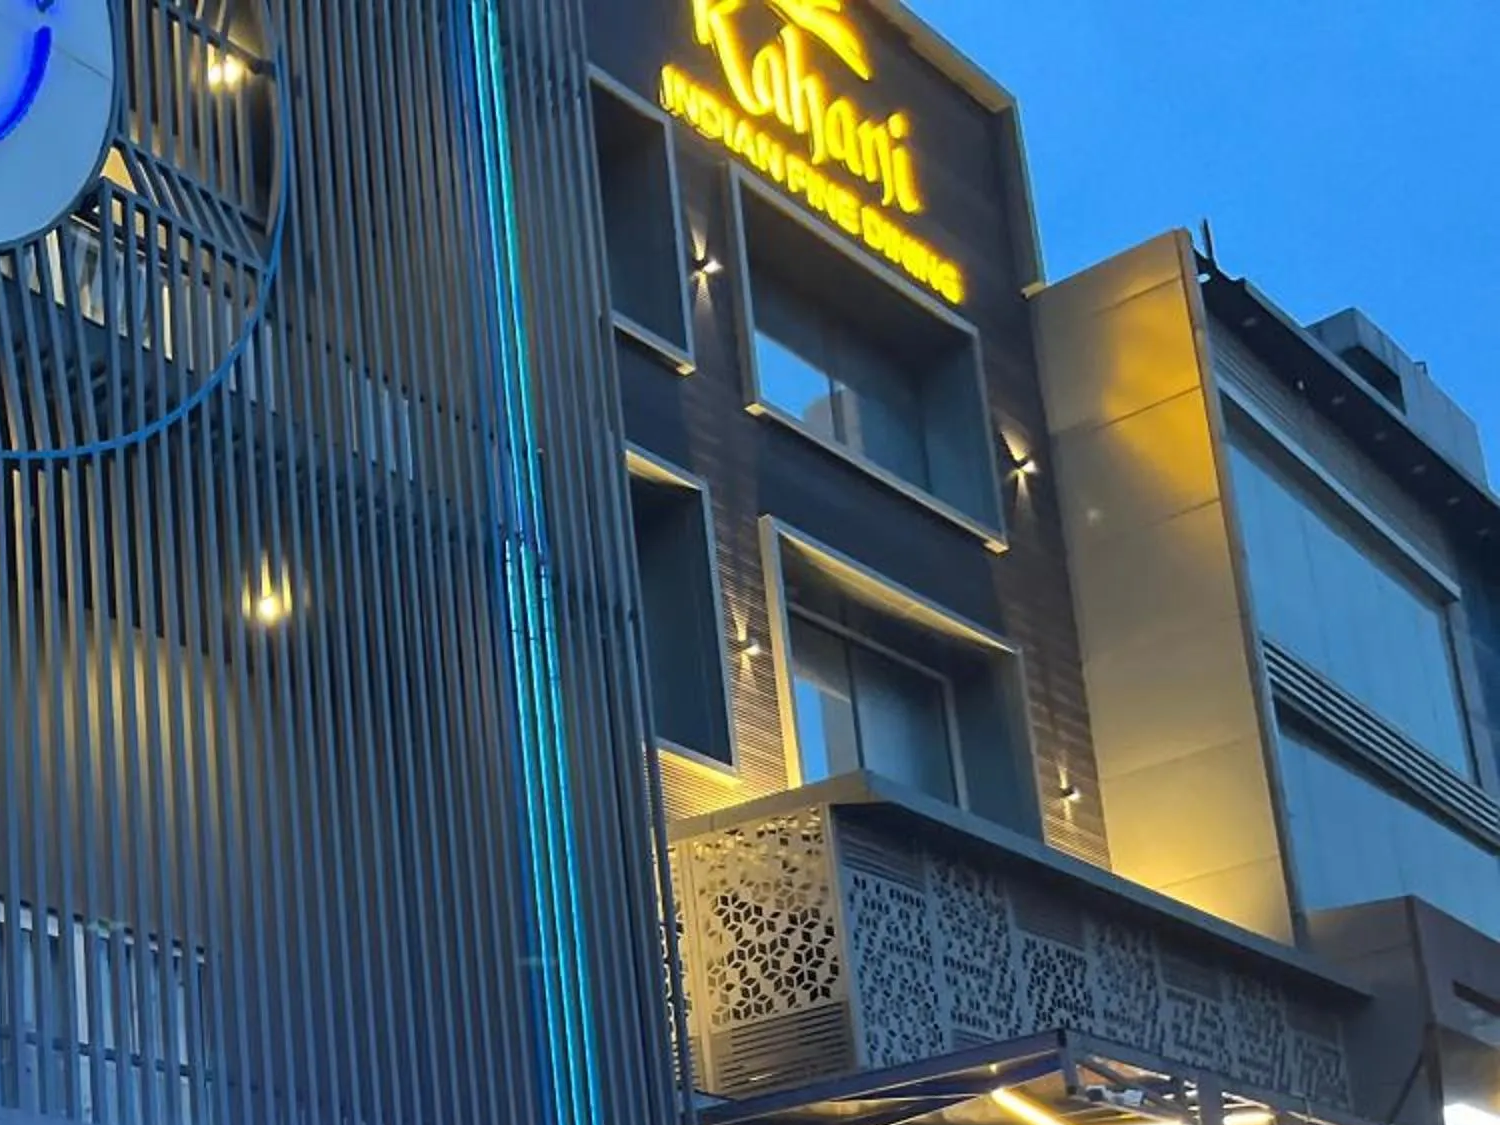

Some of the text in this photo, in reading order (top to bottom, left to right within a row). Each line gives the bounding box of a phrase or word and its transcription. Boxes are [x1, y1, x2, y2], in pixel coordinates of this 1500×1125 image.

[660, 64, 964, 304] INDIAN FINE DINING
